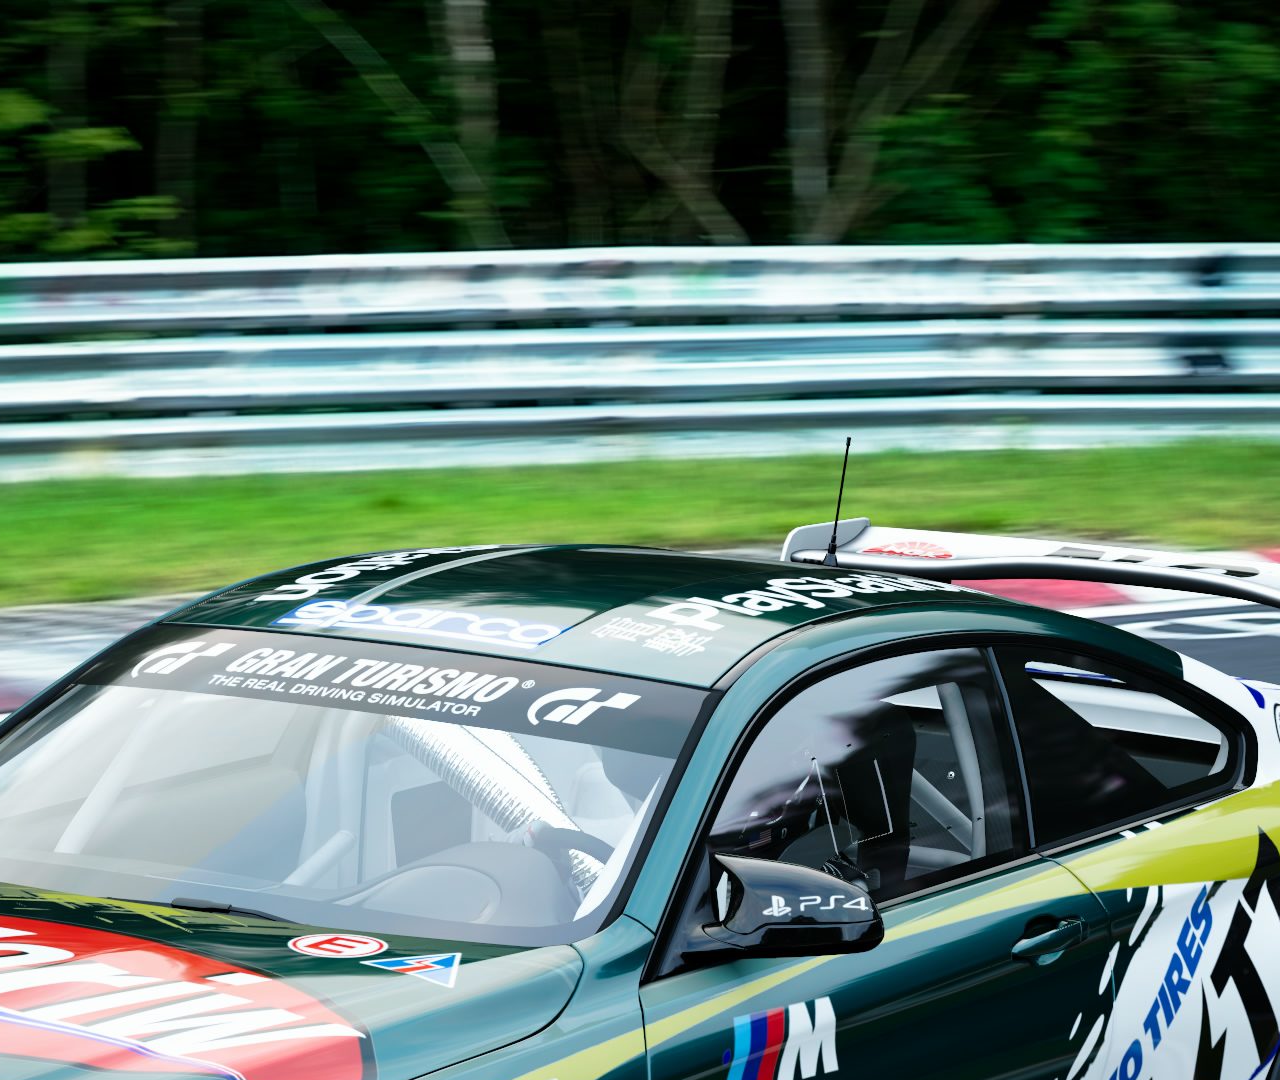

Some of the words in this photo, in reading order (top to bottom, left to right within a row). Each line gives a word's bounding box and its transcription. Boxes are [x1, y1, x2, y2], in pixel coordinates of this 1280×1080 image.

[645, 574, 993, 631] PlayStatio
[226, 647, 347, 680] GRAN
[208, 674, 242, 687] THE
[240, 677, 285, 692] REAL
[288, 683, 364, 702] DRIVING
[367, 691, 482, 717] SIMULATOR
[799, 895, 870, 911] PS4
[1143, 884, 1214, 1050] TIRES
